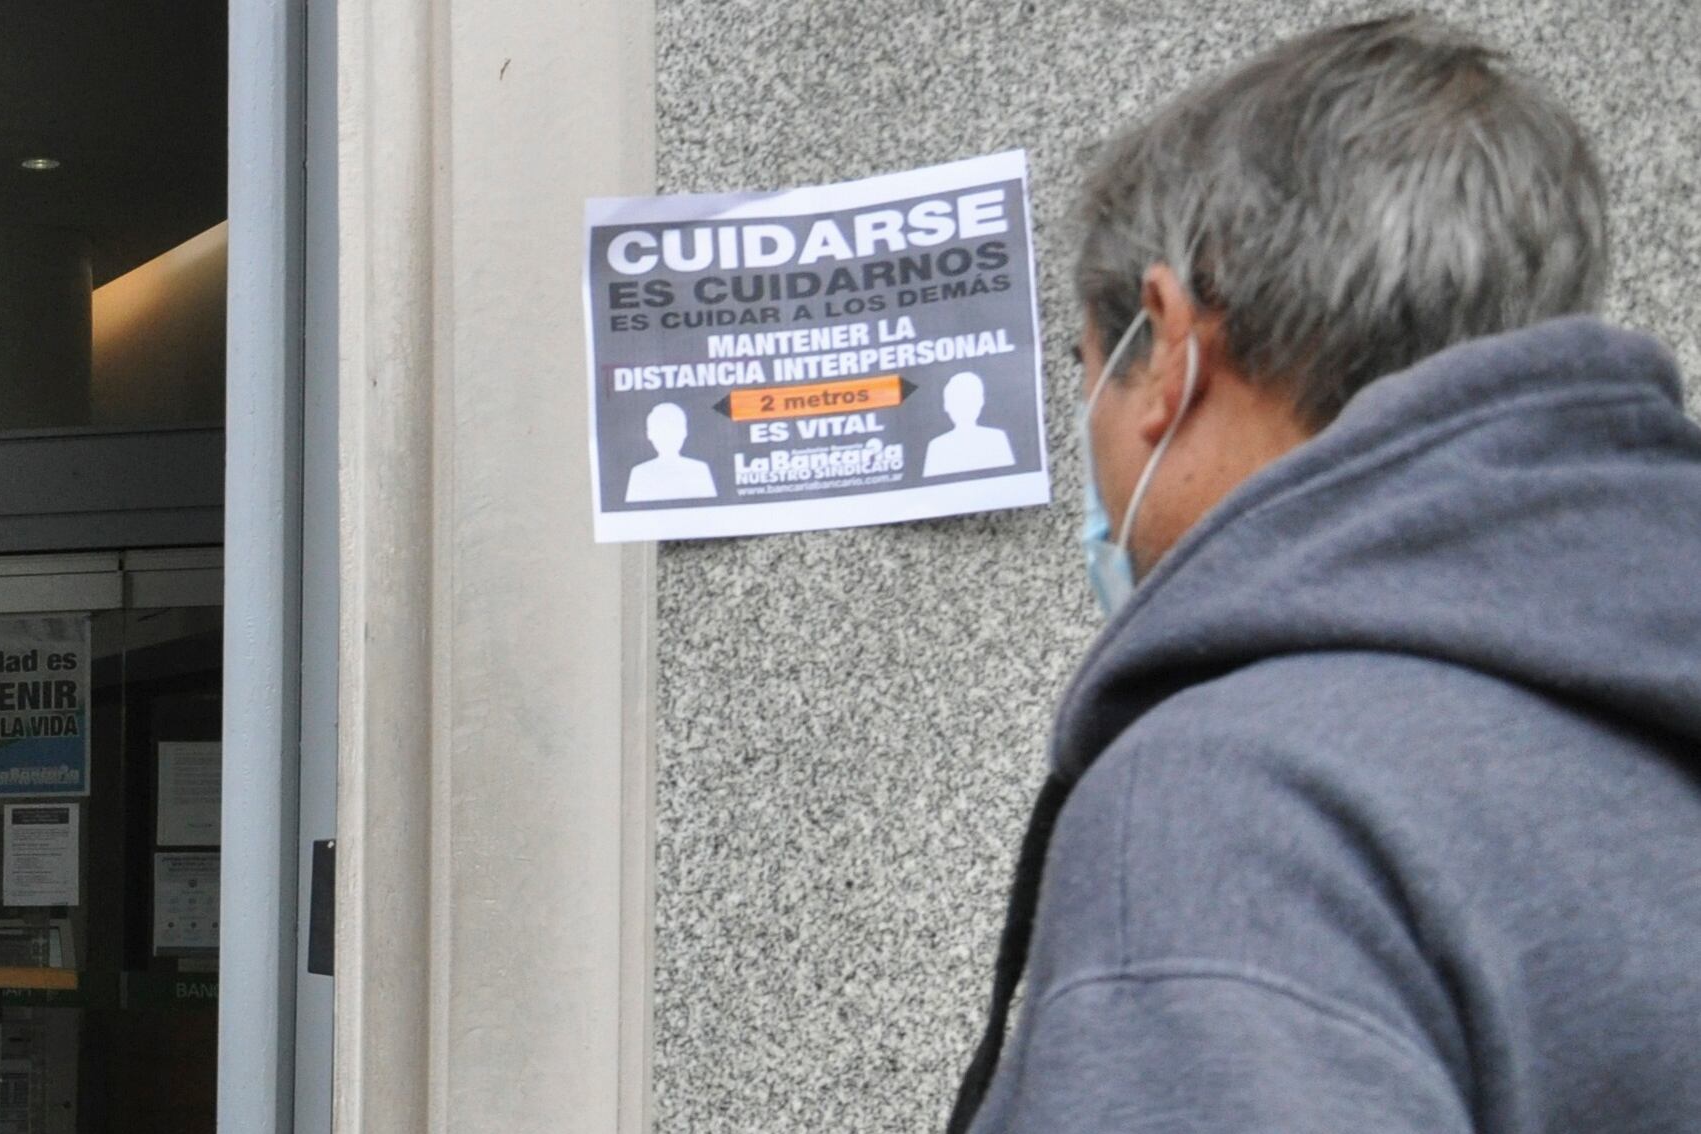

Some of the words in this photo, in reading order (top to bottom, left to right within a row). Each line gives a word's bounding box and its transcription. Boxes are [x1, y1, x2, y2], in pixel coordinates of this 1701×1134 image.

[606, 188, 1009, 275] CUIDARSE
[608, 277, 674, 310] ES
[693, 240, 1011, 306] CUIDARNOS
[610, 313, 656, 332] ES
[660, 306, 781, 330] CUIDAR
[791, 304, 814, 322] A
[824, 295, 888, 318] LOS
[899, 273, 1012, 309] DEMÁS
[707, 325, 866, 359] MANTENER
[878, 316, 917, 342] LA
[613, 360, 765, 391] DISTANCIA
[774, 329, 1015, 382] INTERPERSONAL
[760, 394, 776, 412] 2
[783, 387, 870, 410] metros
[750, 422, 790, 443] ES
[797, 413, 885, 439] VITAL
[735, 467, 814, 485] NUESTRO
[814, 459, 904, 479] SINDICATO
[47, 652, 78, 671] es
[0, 716, 25, 738] LA
[30, 715, 78, 737] VIDA
